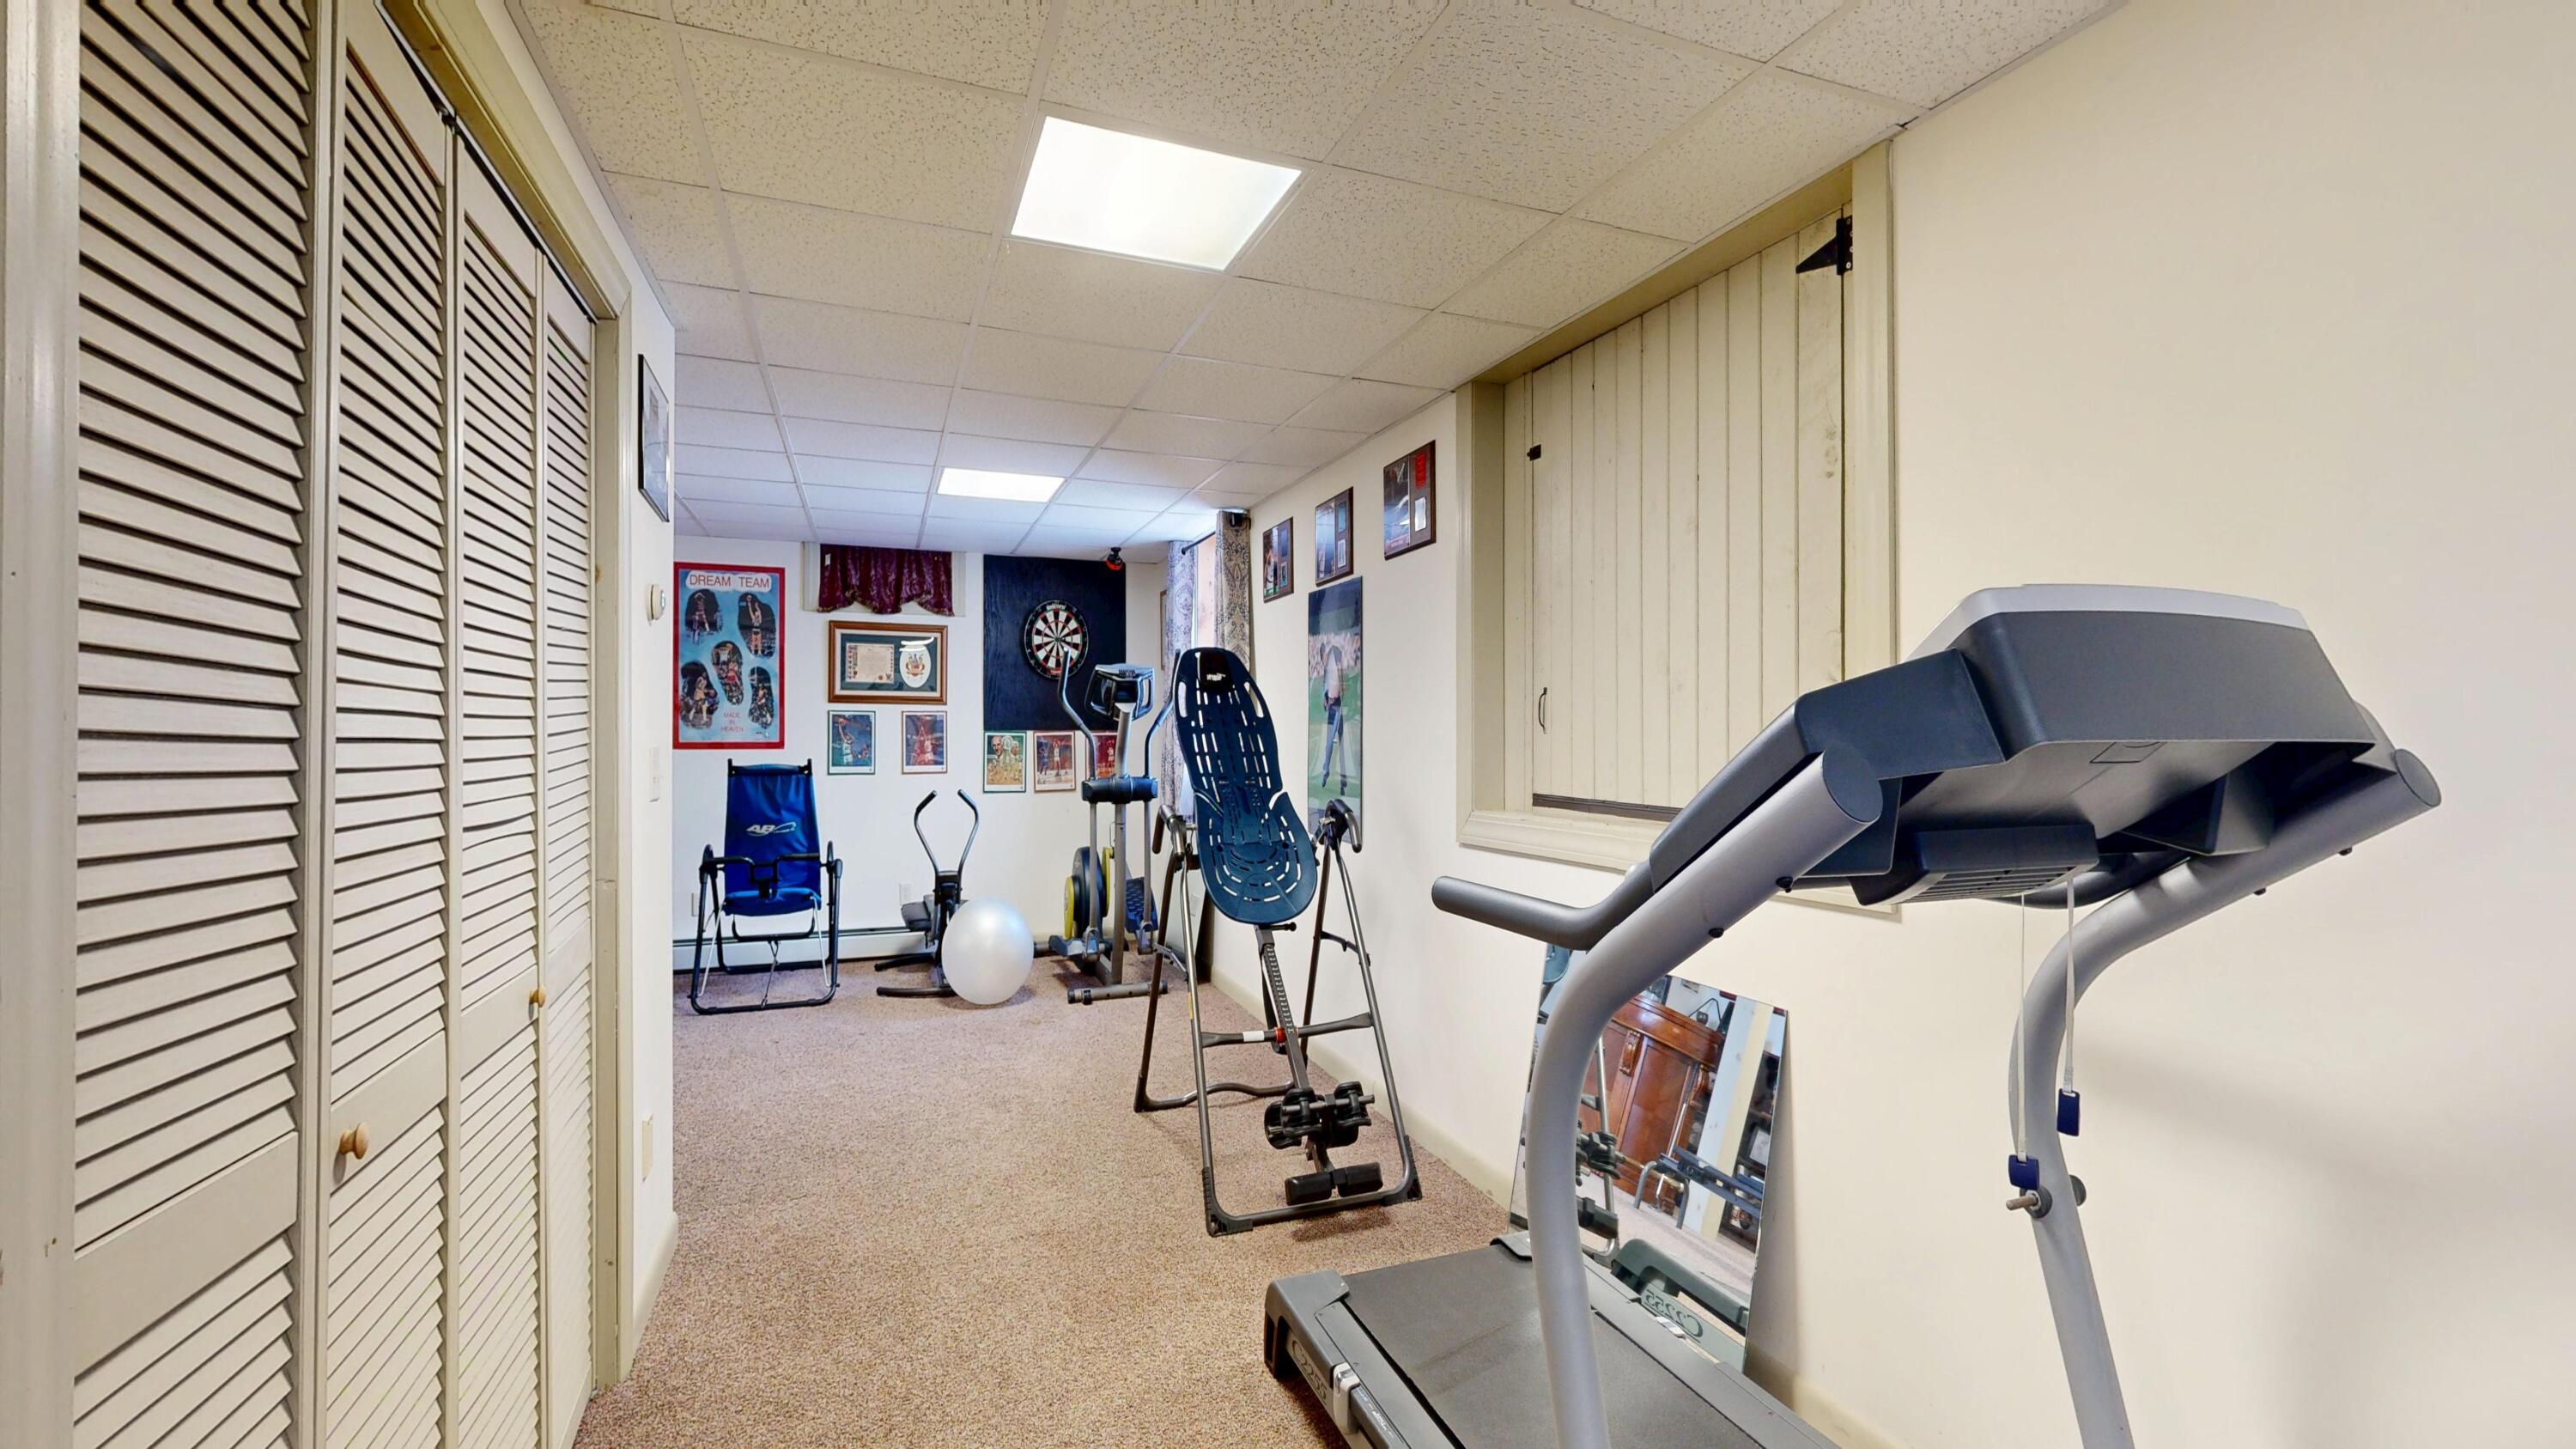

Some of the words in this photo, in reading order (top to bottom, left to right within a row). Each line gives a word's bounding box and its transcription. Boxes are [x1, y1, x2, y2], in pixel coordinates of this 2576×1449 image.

[690, 575, 731, 587] DREAM
[738, 576, 769, 588] TEAM
[1291, 1340, 1327, 1401] C2255
